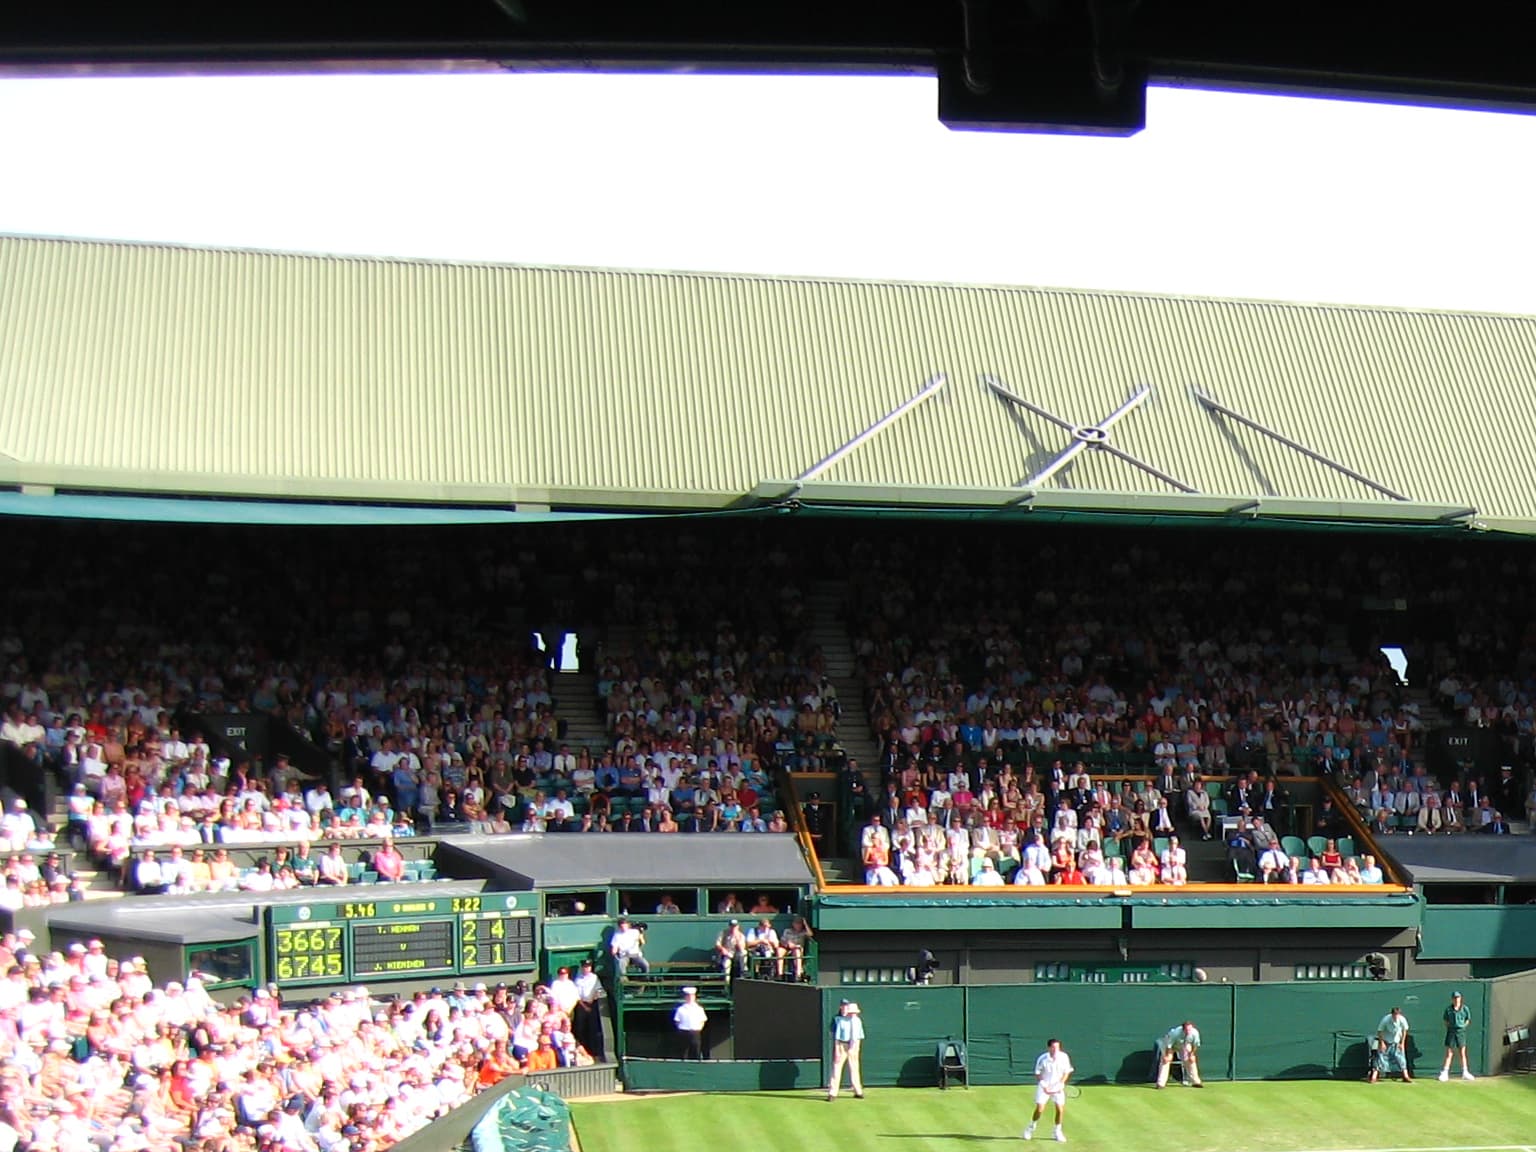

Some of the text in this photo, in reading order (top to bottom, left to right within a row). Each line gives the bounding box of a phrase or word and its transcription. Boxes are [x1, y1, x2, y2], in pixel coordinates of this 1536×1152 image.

[227, 727, 246, 736] EXIT
[1448, 737, 1468, 745] EXIT
[463, 919, 505, 941] 2 4
[463, 943, 504, 966] 2 1
